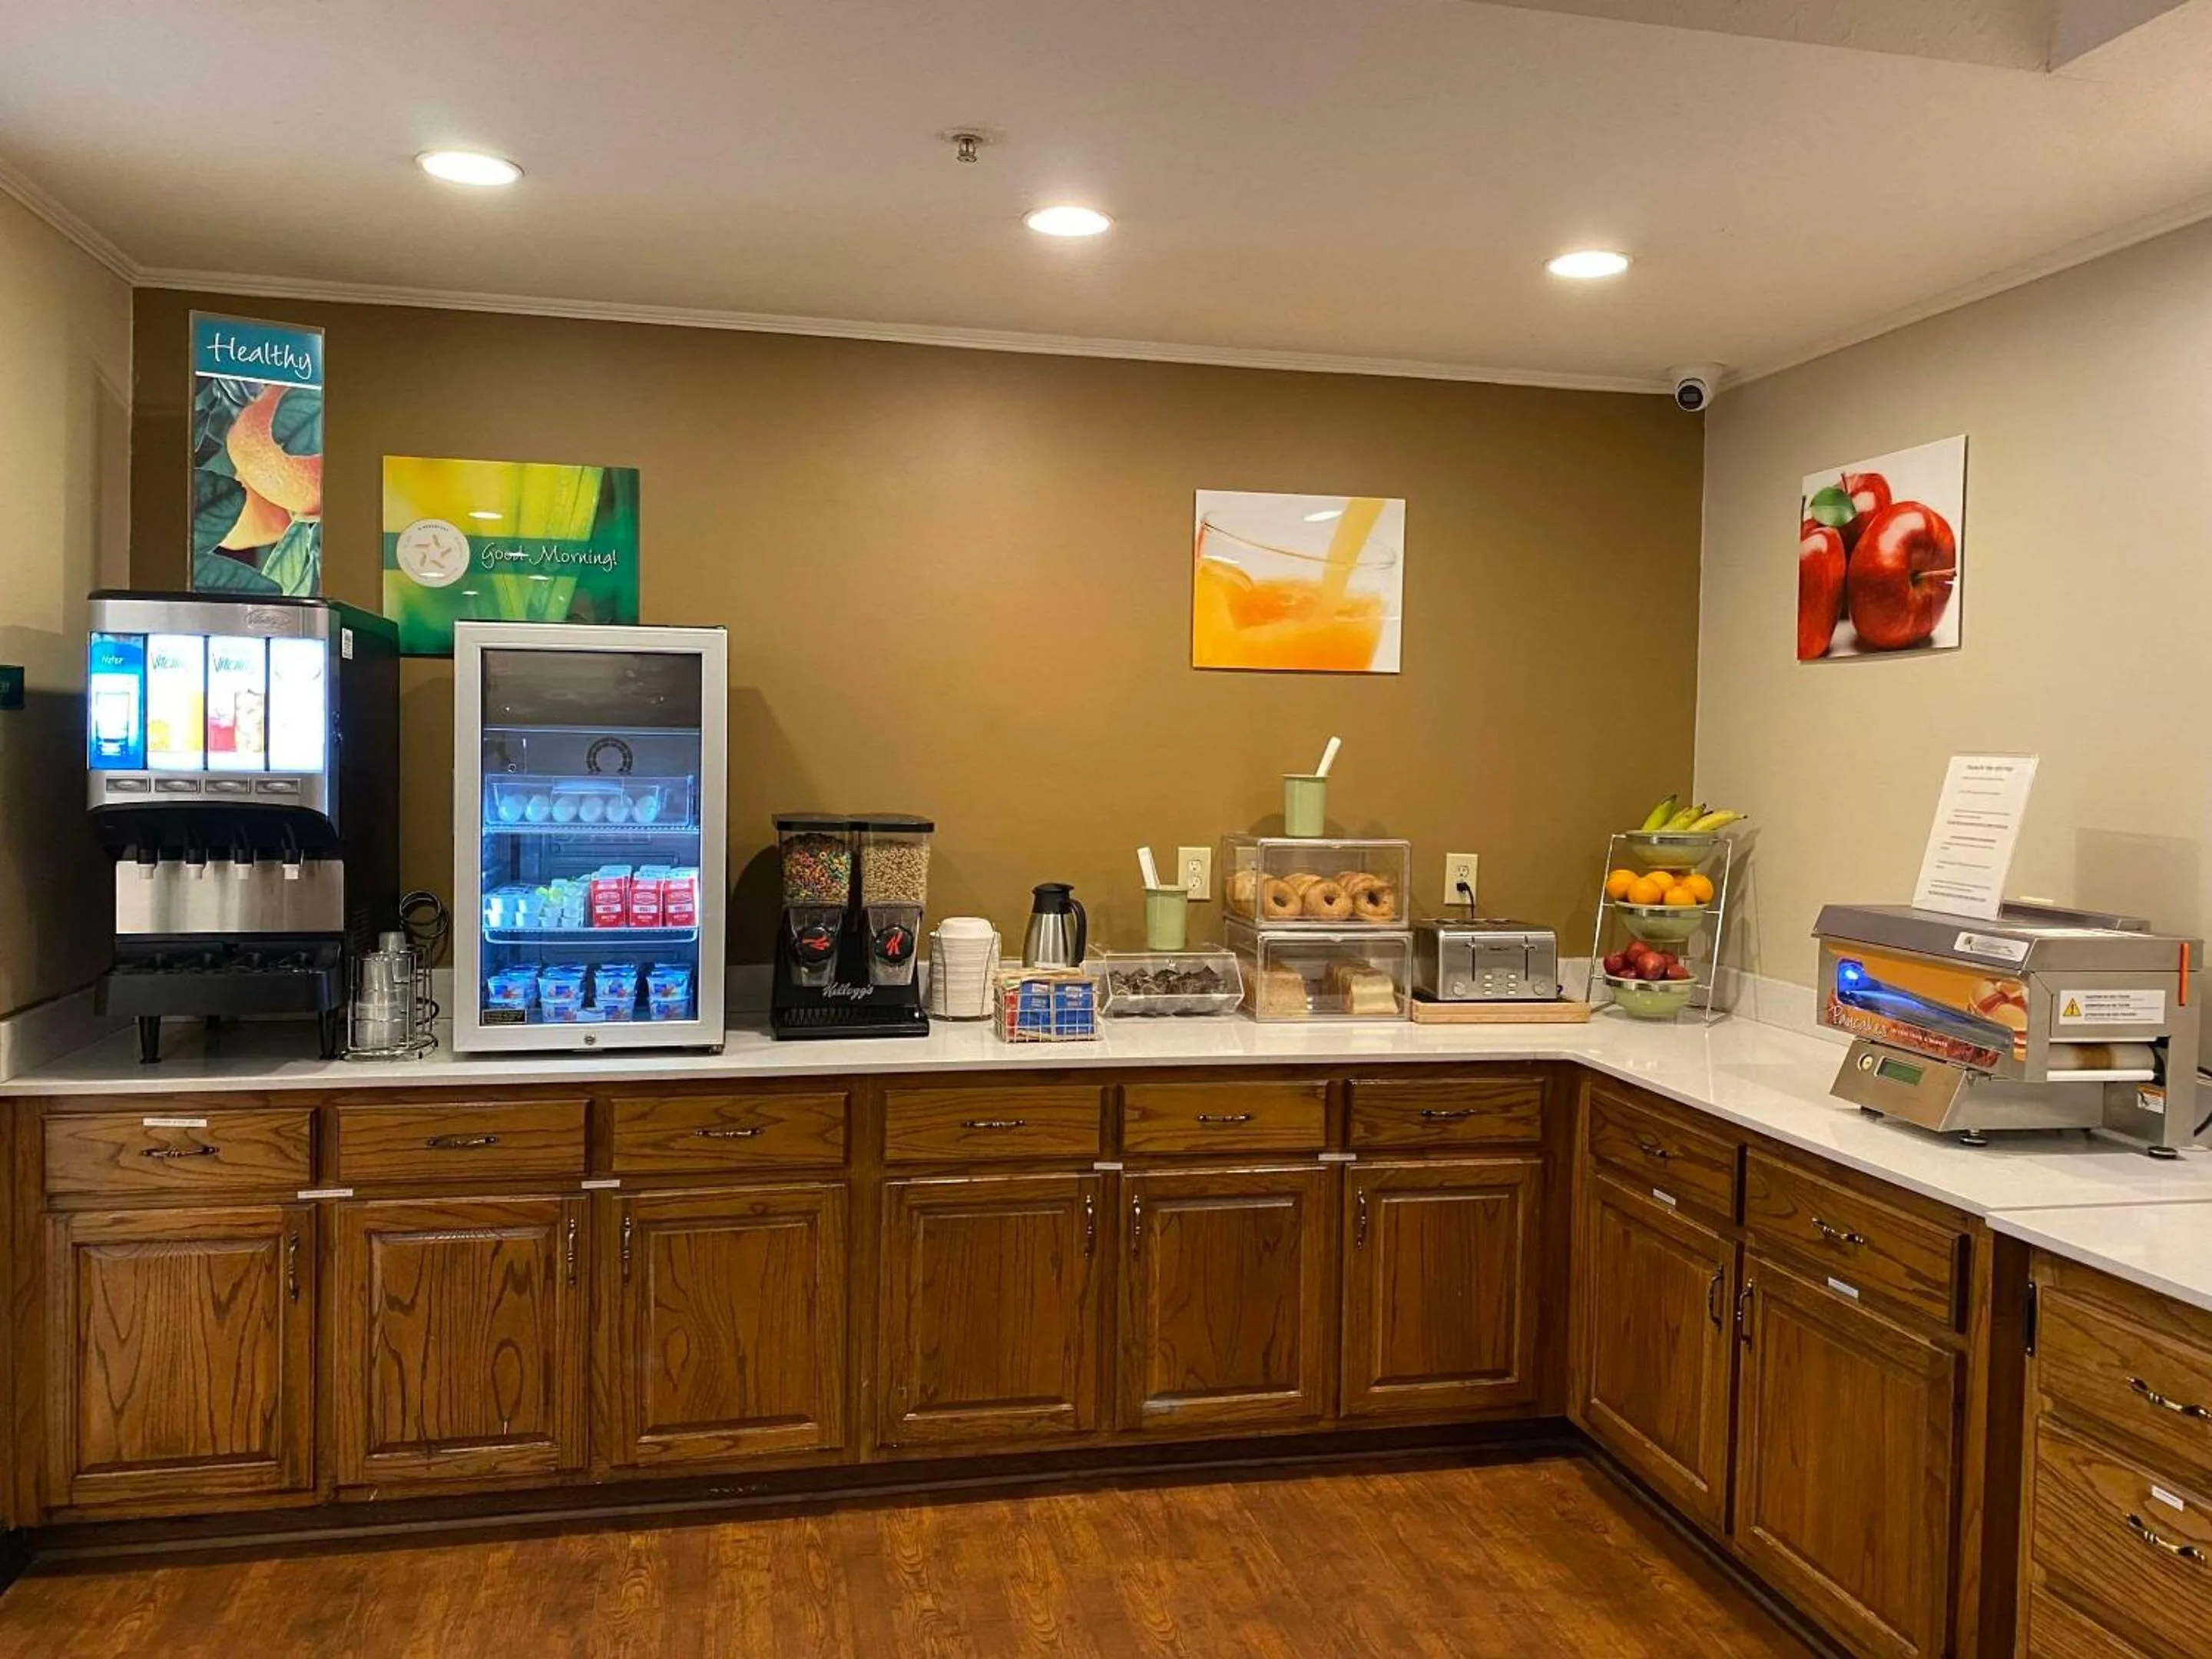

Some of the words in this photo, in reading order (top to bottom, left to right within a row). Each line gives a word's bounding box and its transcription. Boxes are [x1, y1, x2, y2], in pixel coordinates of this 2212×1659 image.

[206, 333, 313, 380] Healthy
[482, 542, 525, 569] Good
[528, 545, 618, 573] Morning!
[822, 981, 875, 1001] Kellogg's
